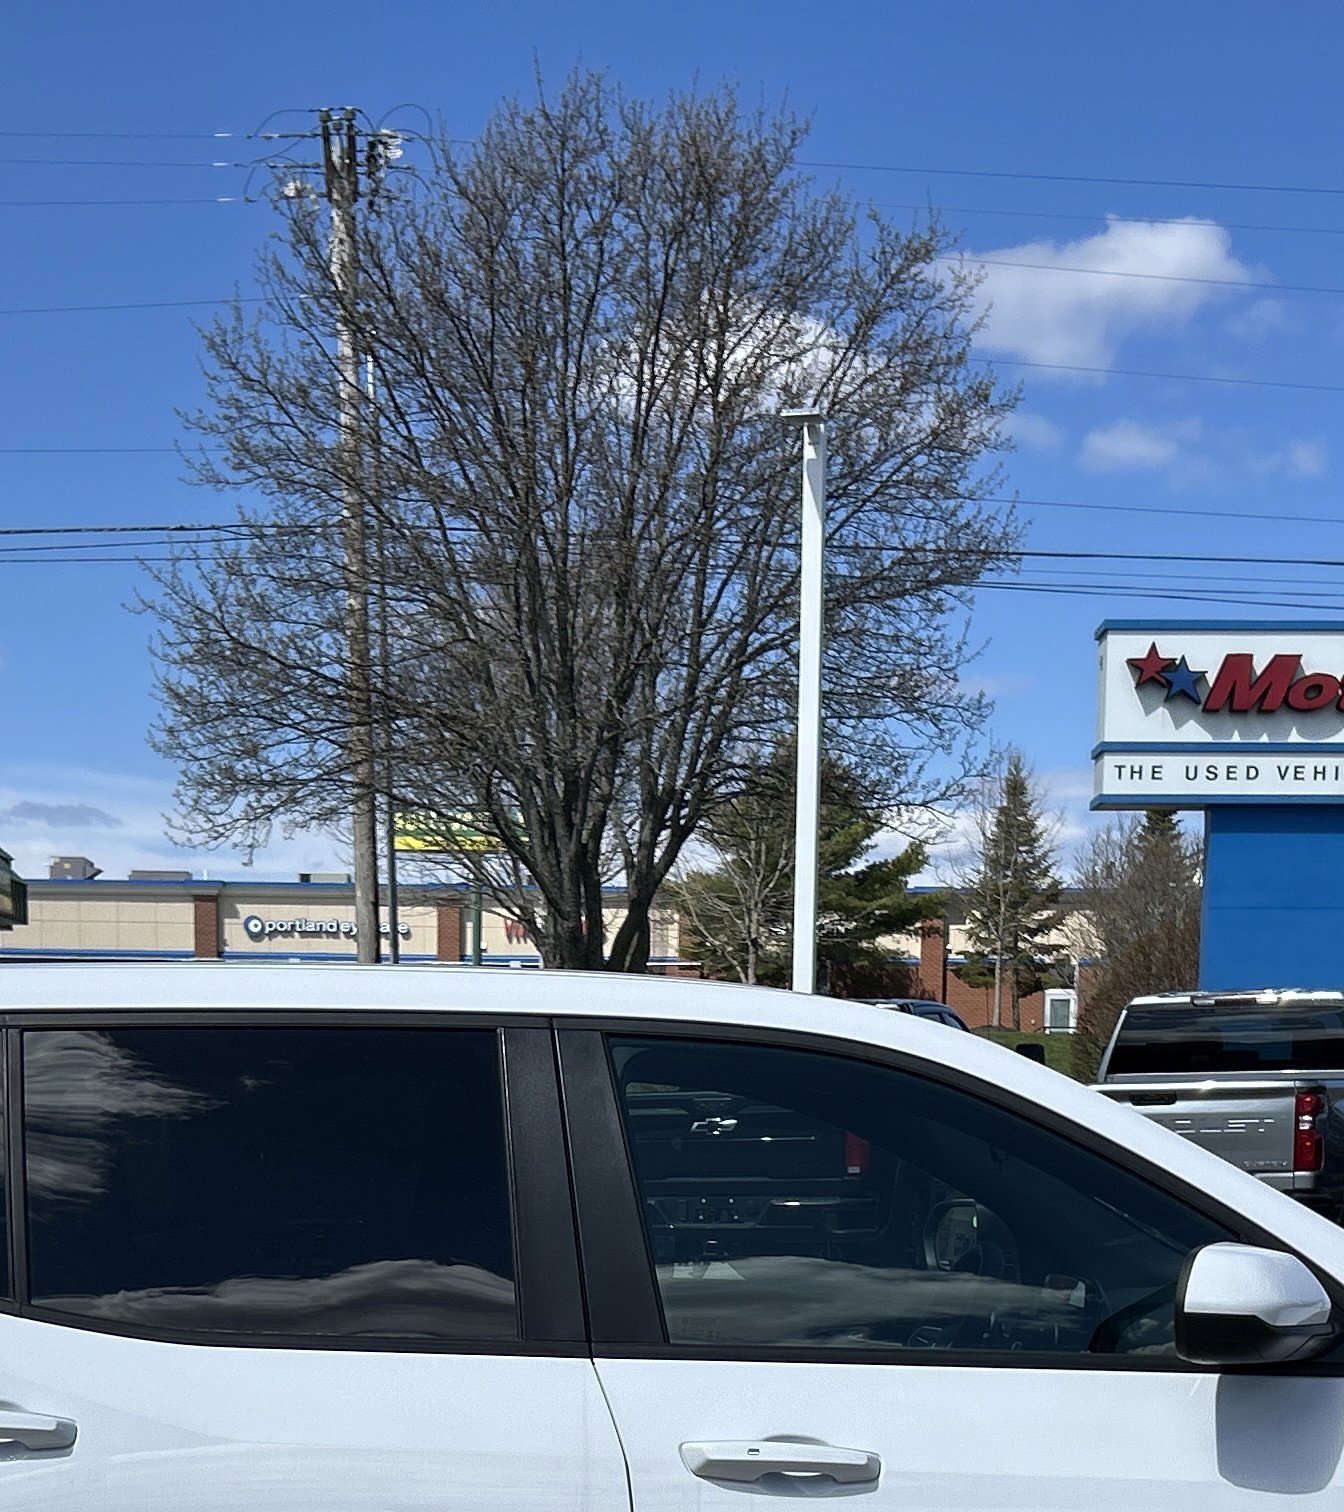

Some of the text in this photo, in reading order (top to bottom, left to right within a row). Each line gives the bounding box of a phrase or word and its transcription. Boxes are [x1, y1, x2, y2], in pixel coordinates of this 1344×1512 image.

[1114, 764, 1164, 782] THE
[1184, 764, 1260, 782] USED
[264, 919, 338, 934] portland
